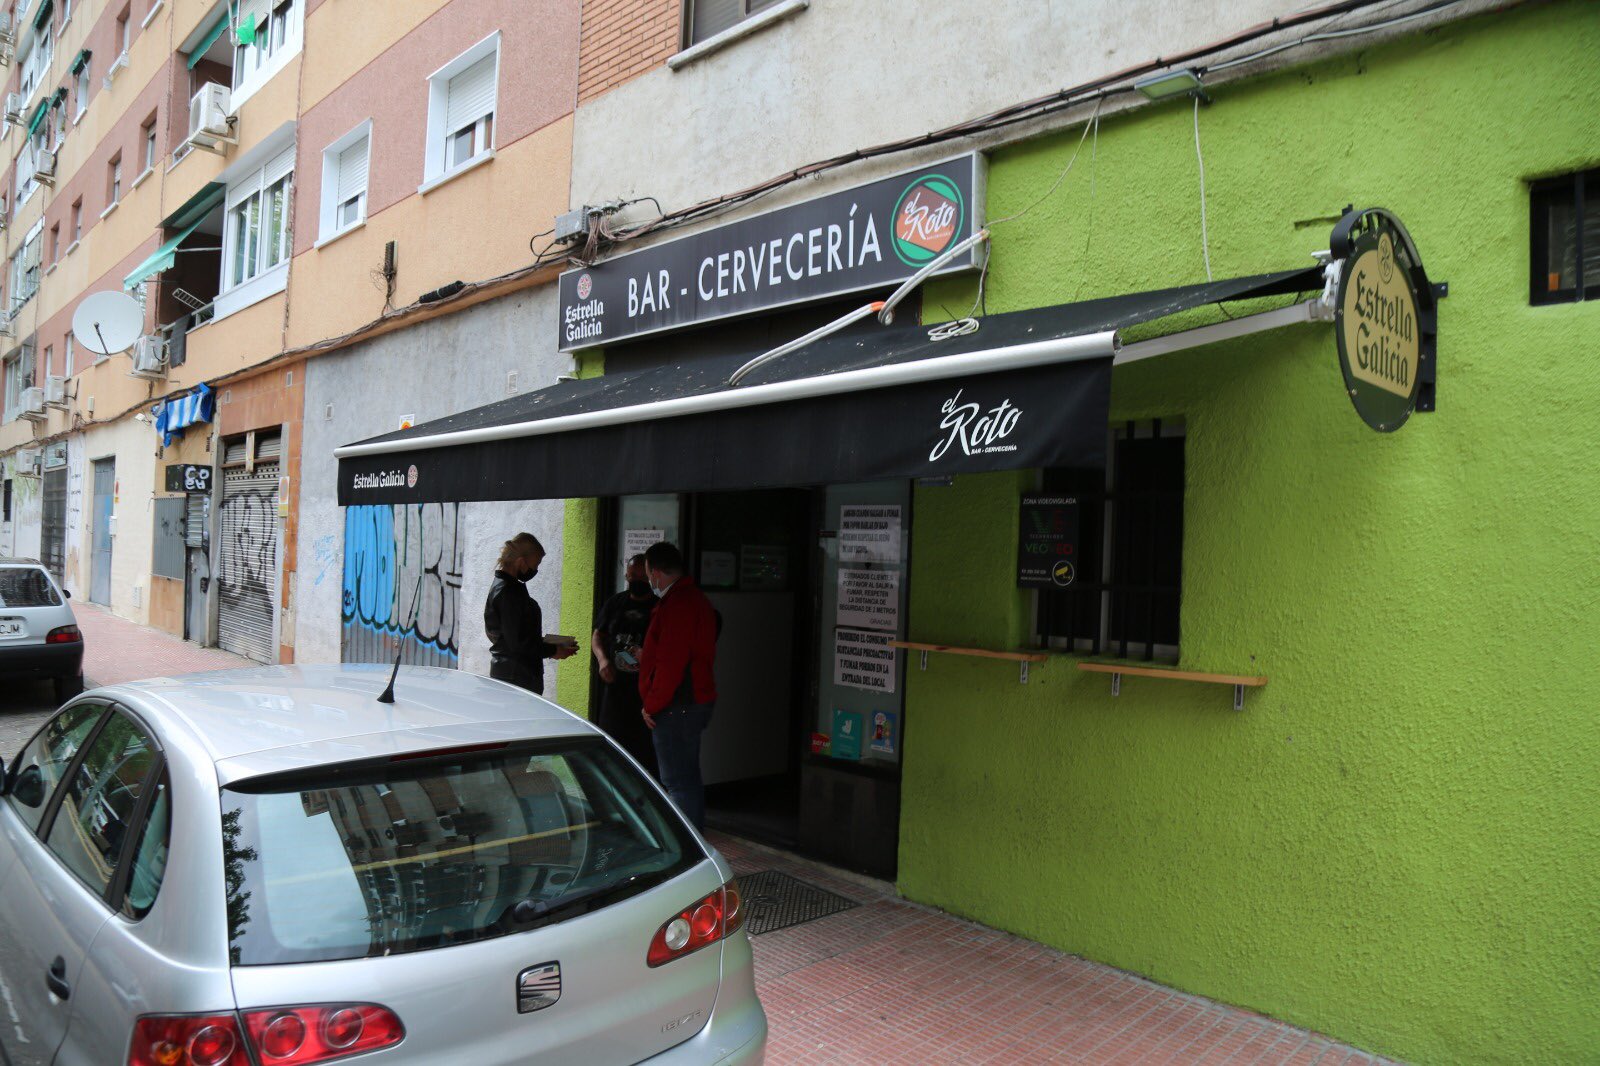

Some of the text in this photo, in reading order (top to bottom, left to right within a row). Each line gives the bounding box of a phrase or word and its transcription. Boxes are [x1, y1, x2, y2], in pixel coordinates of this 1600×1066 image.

[904, 192, 921, 214] el
[901, 201, 956, 241] Roto
[628, 269, 671, 318] BAR
[698, 203, 883, 301] CERVECERÍA
[564, 298, 604, 324] Estrella
[1354, 269, 1412, 343] Estrella
[566, 318, 603, 342] Galicia
[1356, 322, 1409, 388] Galicia
[941, 388, 963, 414] el
[928, 398, 1024, 462] Roto
[353, 469, 405, 489] Estrella Galicia
[1023, 497, 1037, 505] ZONA
[844, 572, 894, 581] ESTIMADOS CLIENTES
[852, 580, 868, 588] FAVOR
[876, 606, 897, 615] METROS
[837, 631, 860, 642] PROHIBIDO
[860, 633, 866, 643] EL
[866, 635, 888, 645] CONSUMO
[836, 645, 863, 656] SUSTANCIAS
[843, 659, 859, 670] FUMAR
[841, 673, 886, 688] ENTRADA DEL LOCAL
